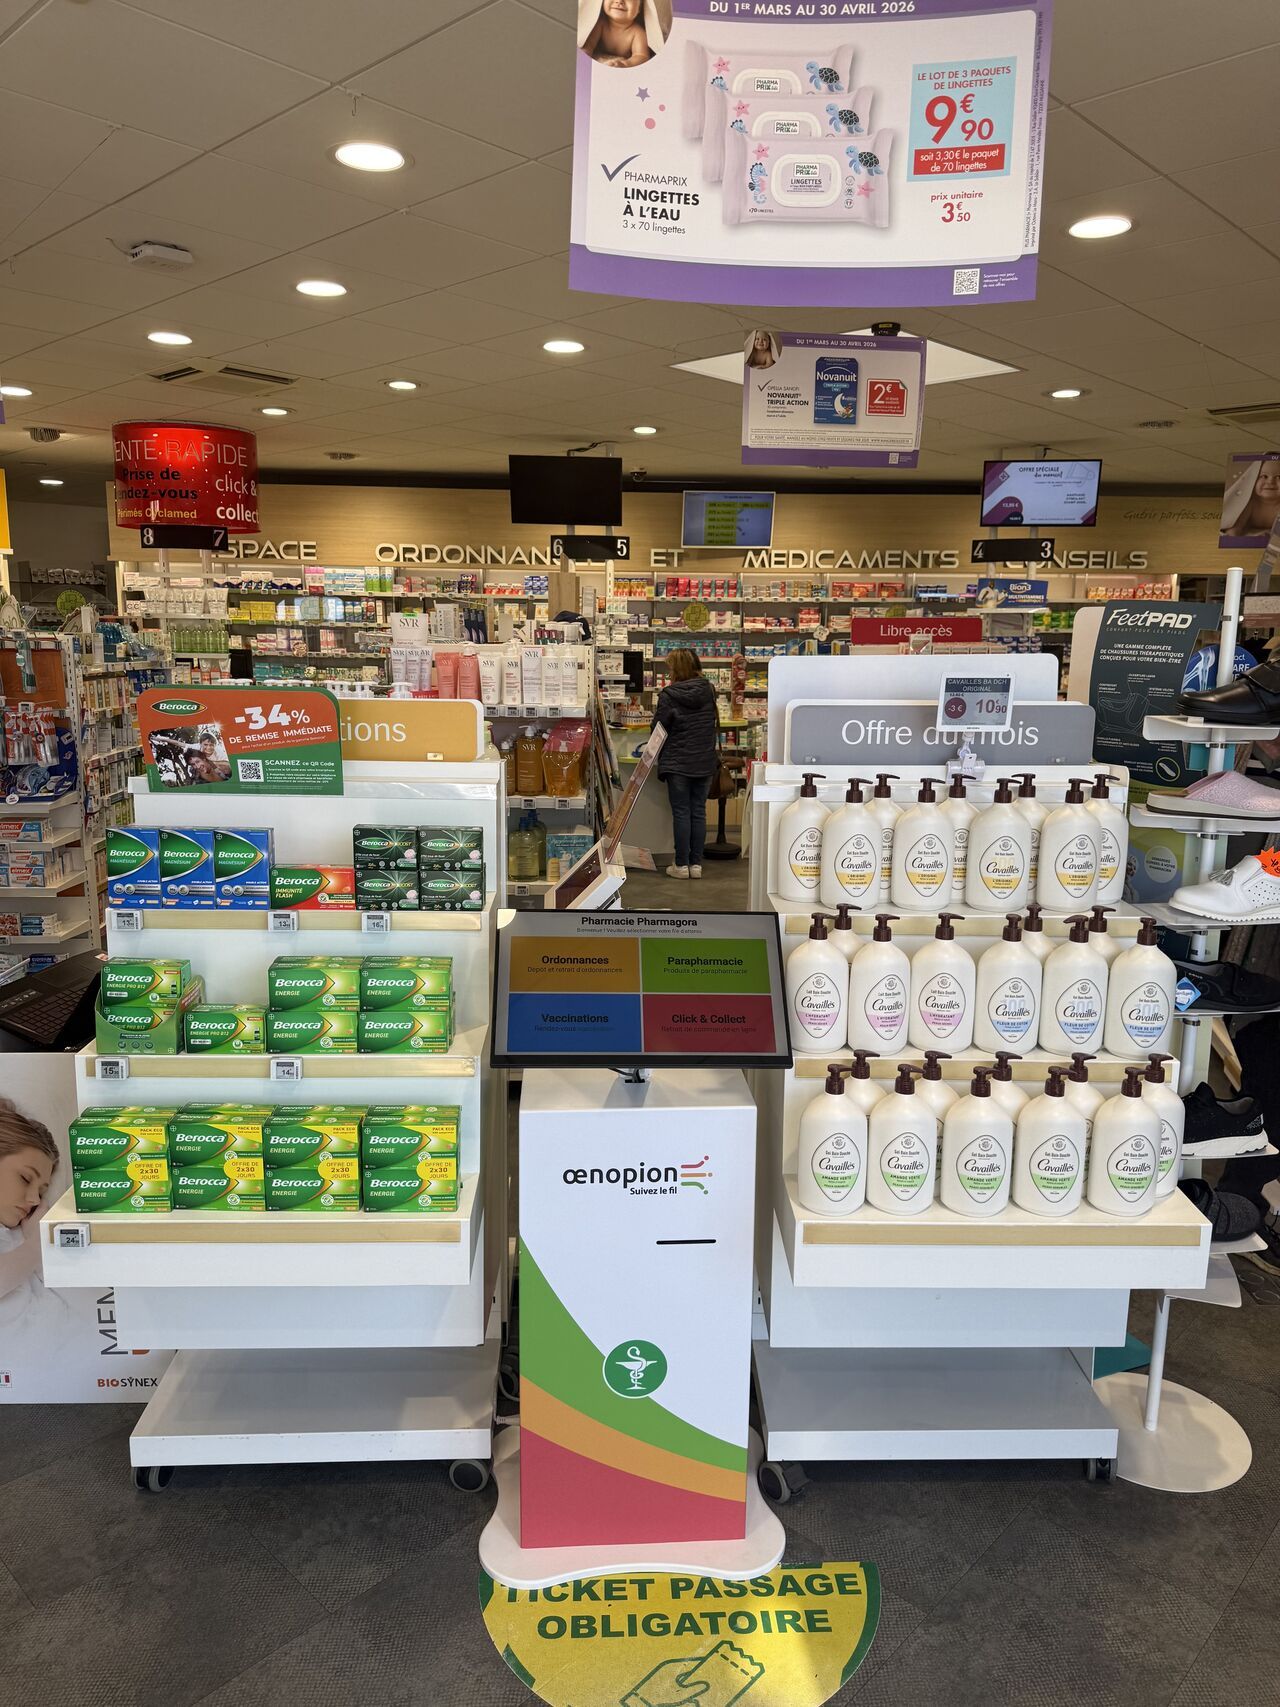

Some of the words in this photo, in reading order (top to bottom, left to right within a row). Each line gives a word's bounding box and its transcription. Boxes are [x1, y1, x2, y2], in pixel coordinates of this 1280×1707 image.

[710, 1, 728, 13] DU
[754, 4, 791, 15] MARS
[796, 5, 814, 15] AU
[819, 5, 836, 15] 30
[840, 3, 876, 15] AVRIL
[881, 1, 915, 13] 2026
[929, 72, 945, 80] LOT
[948, 71, 959, 79] DE
[962, 70, 968, 78] 3
[971, 66, 1012, 78] PAQUETS
[934, 82, 945, 90] DE
[948, 78, 993, 89] LINGETTES
[920, 152, 934, 162] soit
[936, 150, 961, 161] 3,30€
[962, 150, 970, 159] le
[972, 149, 999, 161] paquet
[931, 163, 940, 172] de
[942, 163, 954, 171] 70
[955, 162, 987, 173] lingettes
[624, 171, 688, 187] PHARMAPRIX
[624, 187, 700, 206] LINGETTES
[930, 192, 948, 203] prix
[950, 191, 984, 199] unitaire
[623, 201, 634, 216] À
[640, 206, 680, 221] L'EAU
[623, 220, 628, 229] 3
[639, 222, 650, 231] 70
[652, 222, 686, 235] lingettes
[816, 371, 857, 382] Novanuit
[115, 439, 157, 462] ENTE
[165, 440, 248, 467] RAPIDE
[122, 468, 154, 480] Prise
[160, 468, 180, 480] de
[215, 474, 248, 495] click
[118, 488, 198, 500] endez-vous
[216, 503, 259, 524] collect
[143, 527, 154, 546] 8
[213, 530, 225, 547] 7
[211, 541, 317, 561] SPACE
[376, 542, 605, 566] ORDONNAN
[650, 549, 684, 568] ET
[743, 550, 960, 568] MEDICAMENTS
[553, 539, 563, 556] 6
[616, 540, 627, 556] 5
[973, 542, 984, 558] 4
[1040, 541, 1052, 558] 3
[399, 618, 419, 628] SVR
[880, 624, 911, 637] Libre
[916, 624, 952, 636] accès
[1139, 649, 1184, 658] THÉRAPEUTIQUES
[159, 703, 198, 711] Berocca
[234, 704, 310, 730] -34%
[229, 736, 242, 744] DE
[245, 732, 279, 743] REMISE
[283, 724, 332, 737] IMMÉDIATE
[842, 719, 912, 746] Offre
[923, 730, 958, 746] du
[163, 850, 200, 858] Berocca
[581, 917, 634, 926] Pharmacie
[637, 917, 698, 927] Pharmagora
[542, 956, 609, 964] Ordonnances
[667, 957, 744, 967] Parapharmacie
[541, 1014, 609, 1023] Vaccinations
[672, 1014, 697, 1024] Click
[700, 1014, 708, 1024] &
[710, 1014, 746, 1024] Collect
[563, 1162, 678, 1189] œnopion
[630, 1187, 658, 1195] Suivez
[669, 1186, 678, 1194] fil
[501, 1578, 655, 1603] TICKET
[670, 1573, 862, 1600] PASSAGE
[537, 1609, 833, 1639] OBLIGATOIRE
